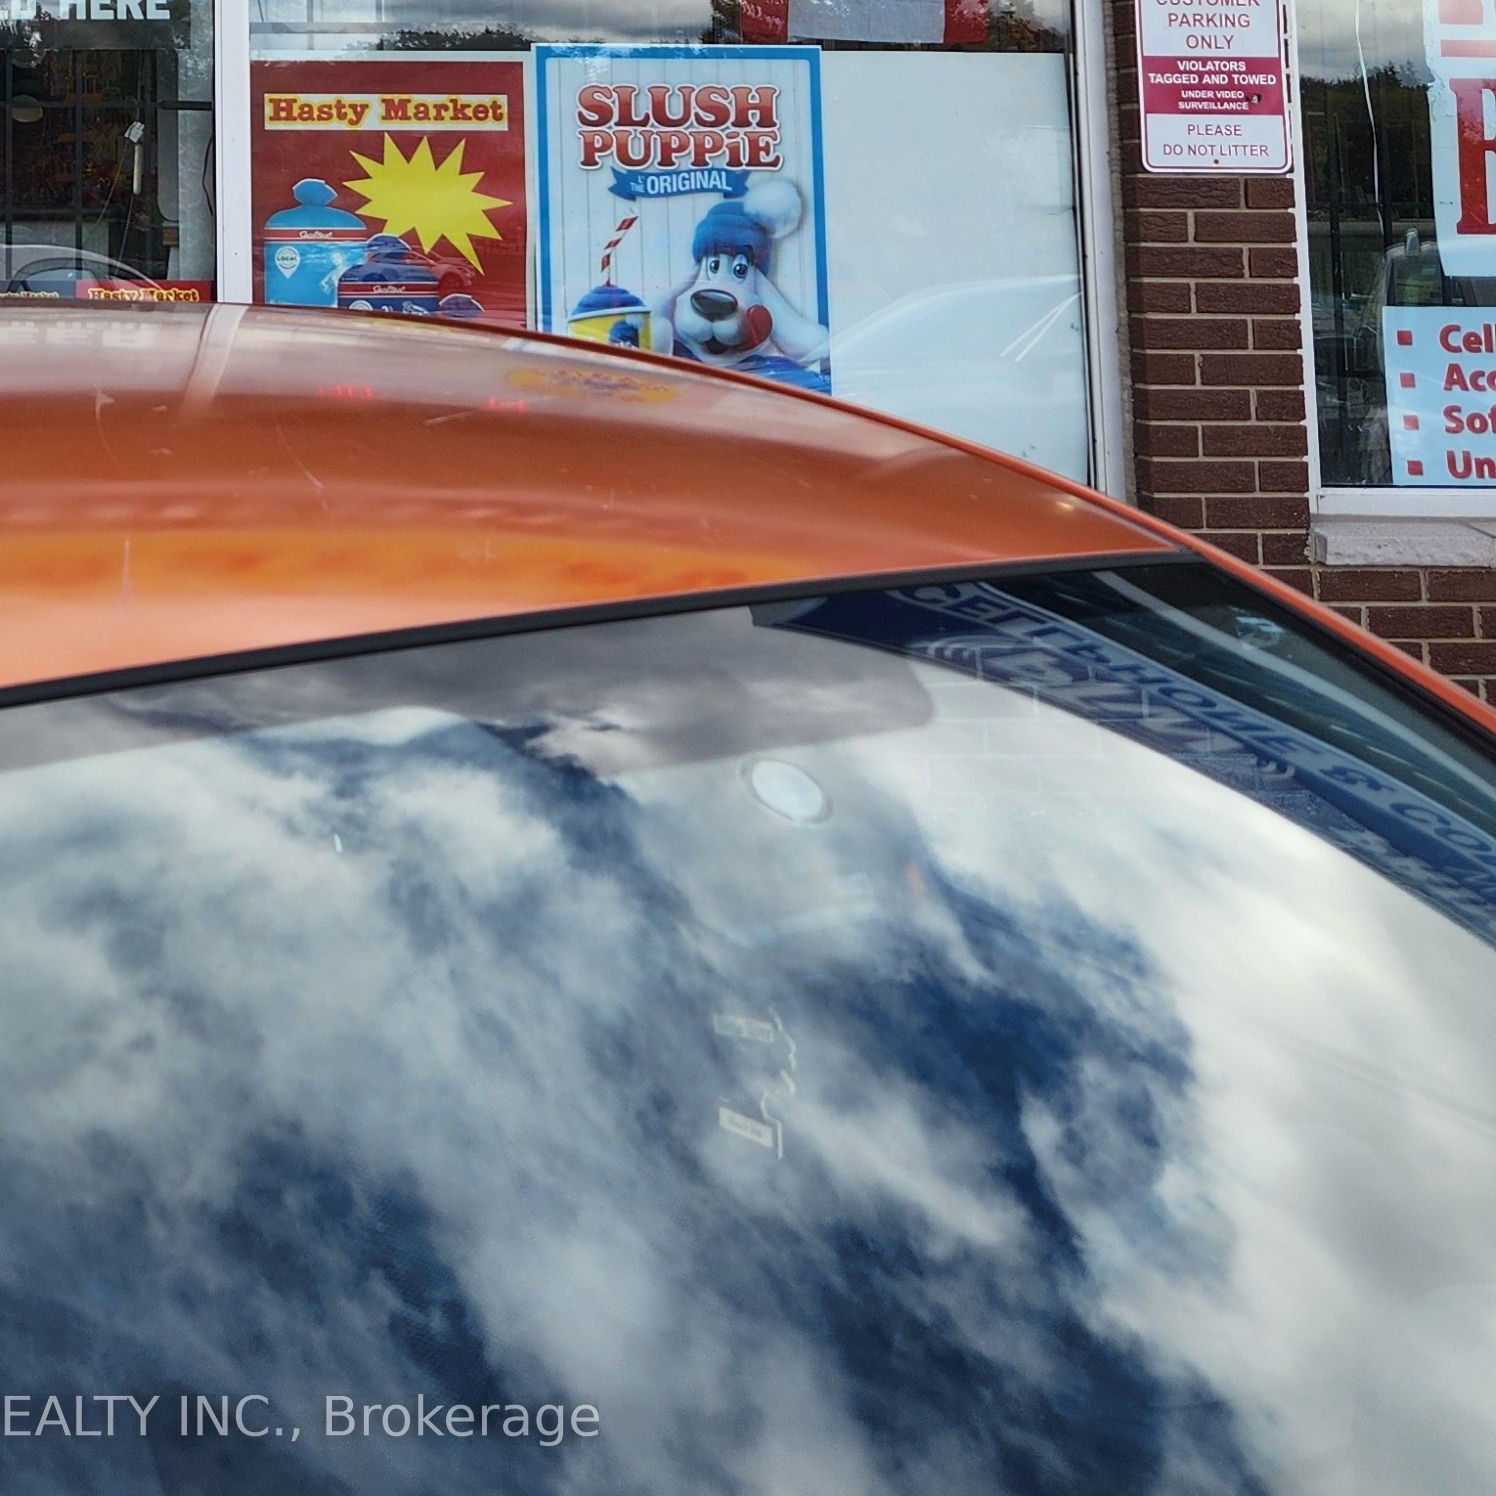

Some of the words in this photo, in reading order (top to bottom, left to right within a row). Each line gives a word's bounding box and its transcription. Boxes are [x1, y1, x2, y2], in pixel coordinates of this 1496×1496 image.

[1168, 13, 1251, 28] PARKING
[1186, 34, 1234, 50] ONLY
[1177, 60, 1246, 71] VIOLATORS
[1148, 73, 1199, 84] TAGGED
[1203, 73, 1229, 84] AND
[1232, 74, 1277, 85] TOWED
[1181, 90, 1214, 99] UNDER
[1215, 90, 1244, 99] VIDEO
[267, 95, 369, 128] Hasty
[380, 95, 505, 124] Market
[576, 84, 779, 129] SLUSH
[1178, 101, 1249, 110] SURVEILLANCE
[1187, 124, 1242, 136] PLEASE
[1163, 144, 1184, 156] DO
[1188, 144, 1215, 156] NOT
[1220, 144, 1269, 156] LITTER
[646, 170, 733, 195] ORIGINAL
[89, 288, 139, 302] Hasty
[141, 288, 200, 302] Market
[1439, 323, 1496, 354] Cel
